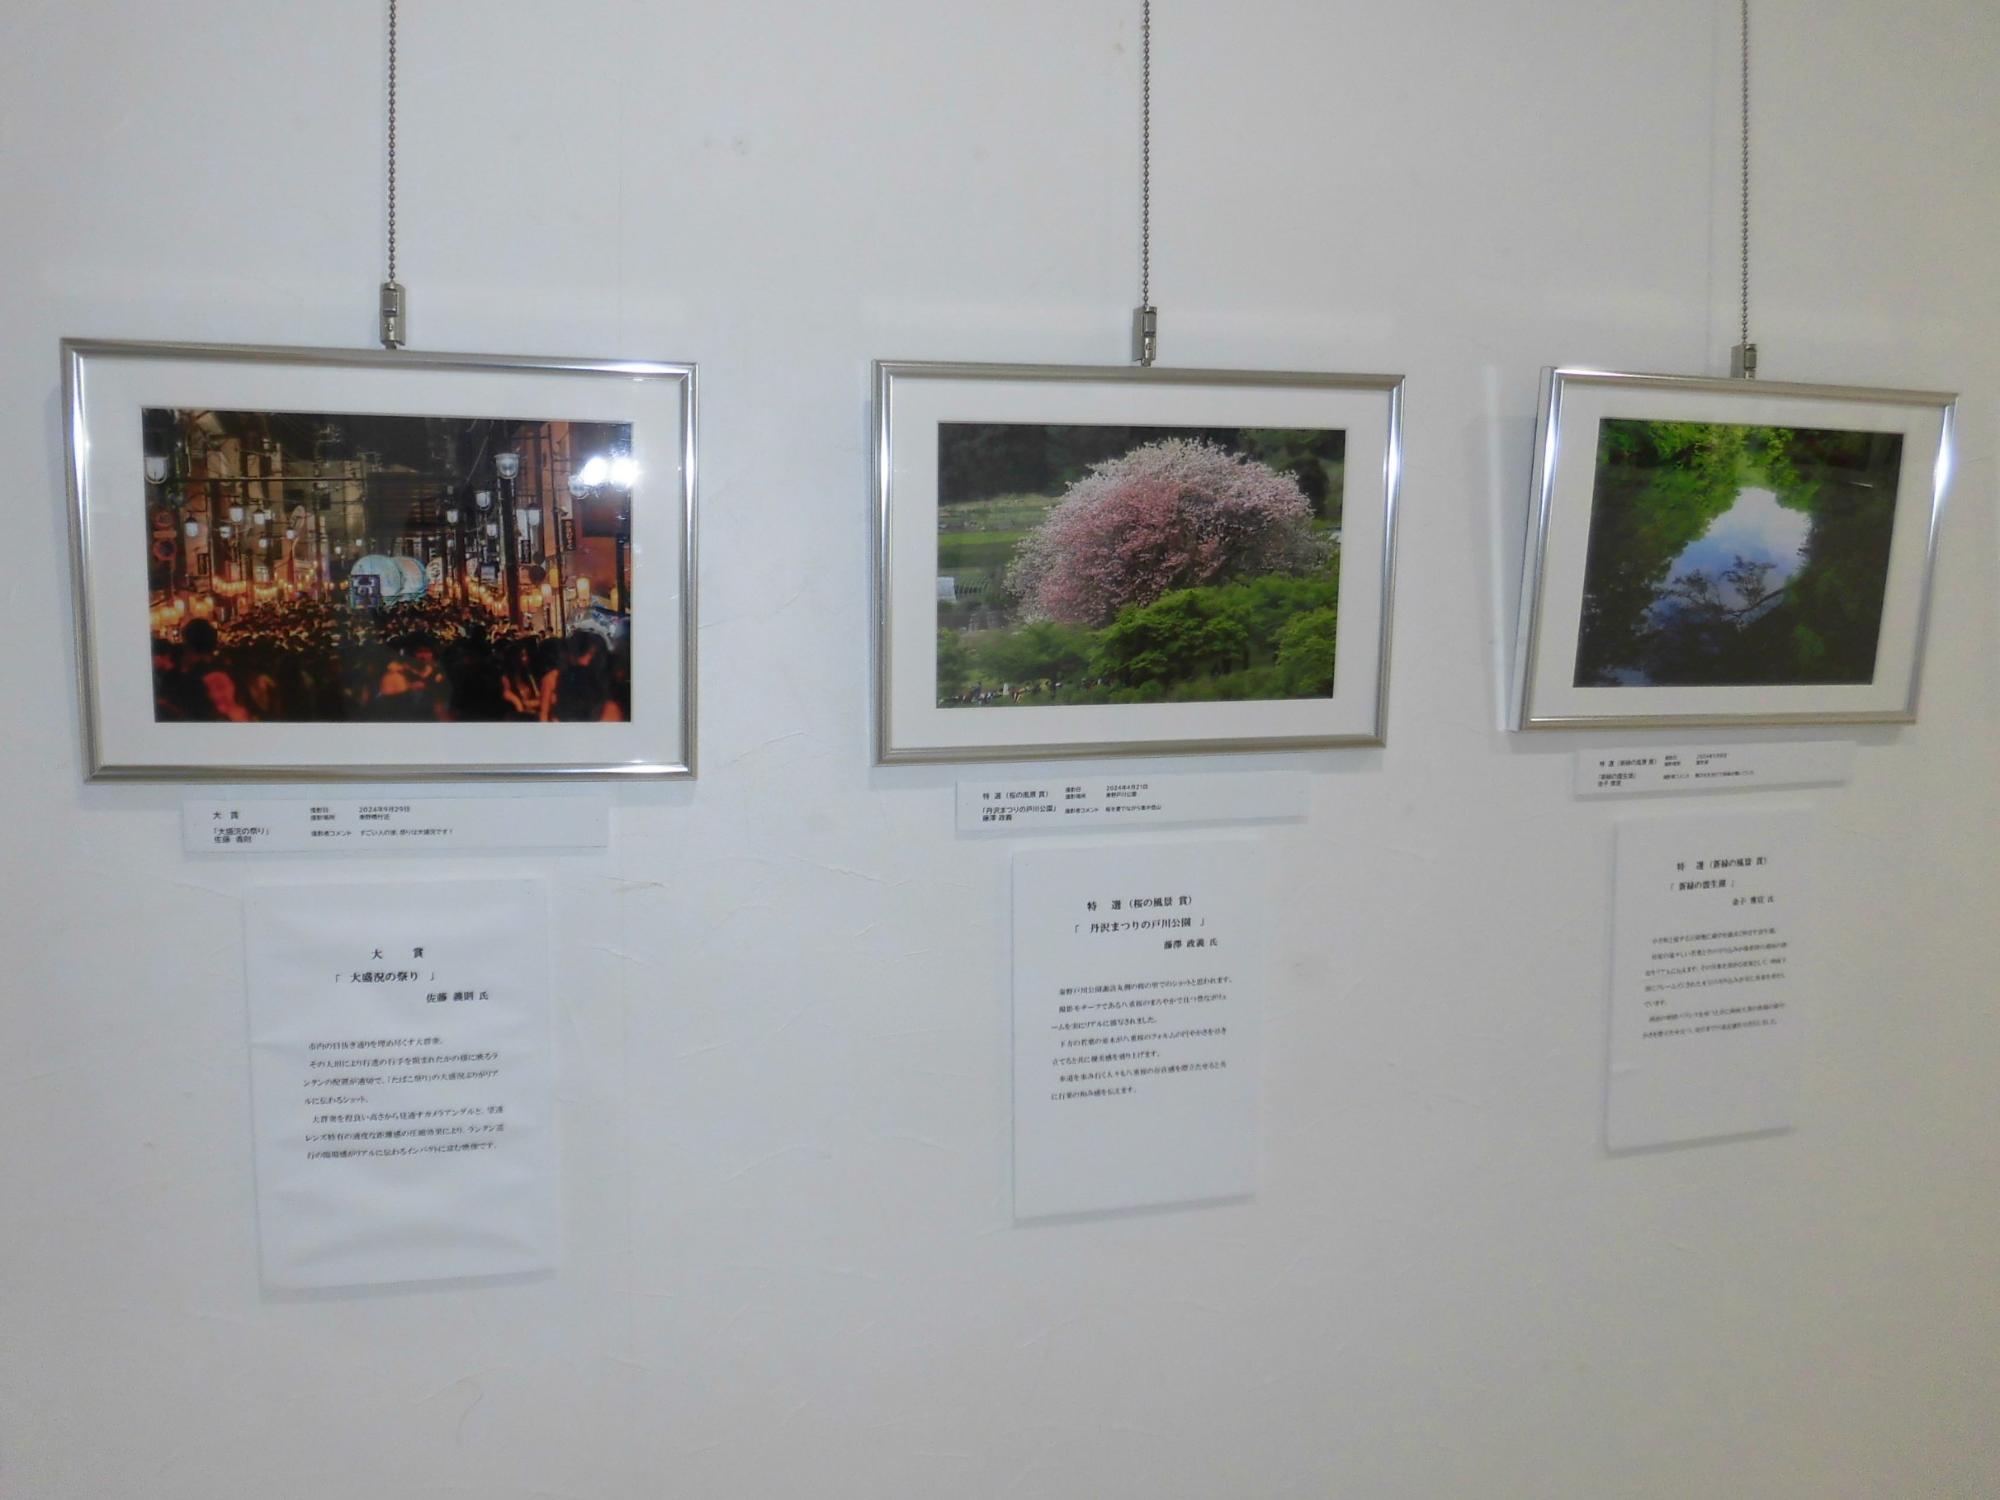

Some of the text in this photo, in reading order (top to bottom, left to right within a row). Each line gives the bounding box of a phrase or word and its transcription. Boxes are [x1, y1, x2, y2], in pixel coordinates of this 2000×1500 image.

[359, 805, 411, 814] 2024年9月29日
[426, 992, 447, 1003] 佐藤
[479, 991, 489, 1001] 氏
